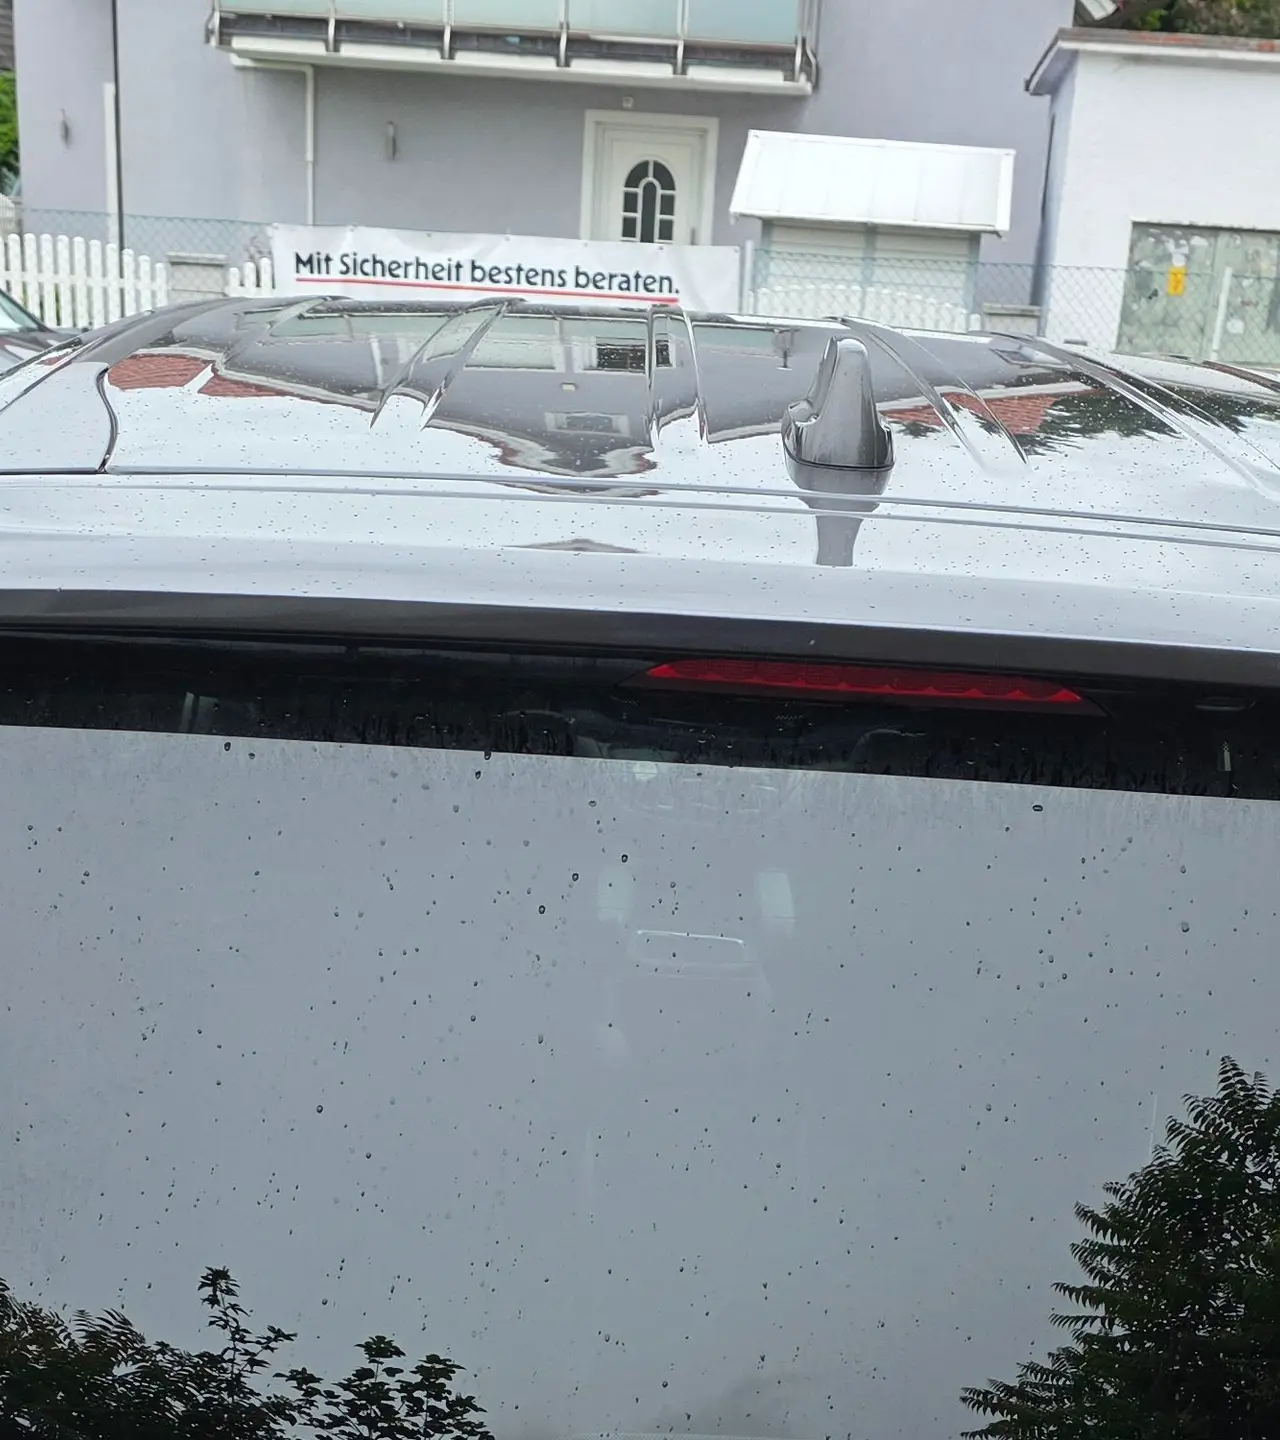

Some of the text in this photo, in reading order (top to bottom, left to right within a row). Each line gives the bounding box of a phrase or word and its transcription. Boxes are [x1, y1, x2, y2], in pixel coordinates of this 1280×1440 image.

[294, 251, 680, 294] Mit Sicherheit bestens beraten.
